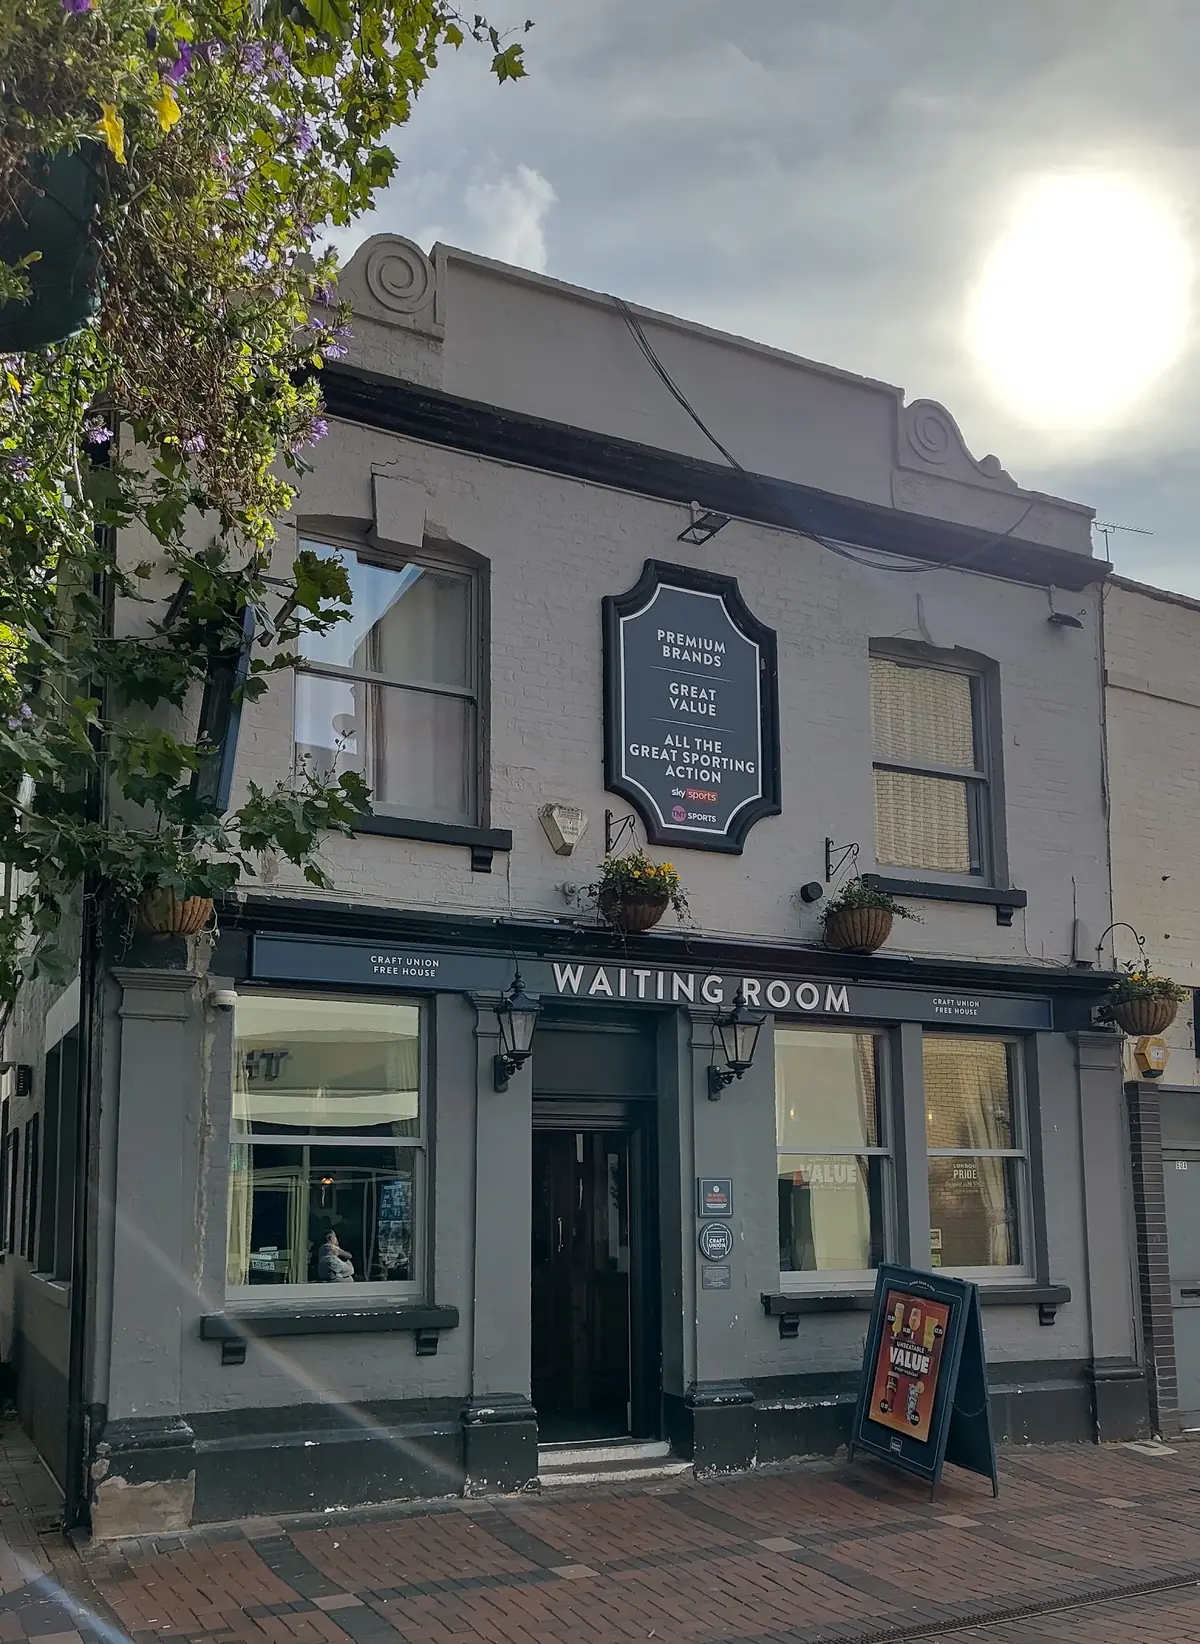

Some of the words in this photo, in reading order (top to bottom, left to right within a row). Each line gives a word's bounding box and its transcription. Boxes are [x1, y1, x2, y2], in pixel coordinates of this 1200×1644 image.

[657, 629, 726, 654] PREMIUM
[662, 645, 722, 667] BRANDS
[669, 682, 717, 701] GREAT
[669, 697, 717, 716] VALUE
[664, 734, 691, 749] ALL
[694, 738, 722, 753] THE
[629, 744, 678, 762] GREAT
[682, 751, 755, 773] SPORTING
[665, 764, 722, 783] ACTION
[671, 787, 686, 799] sky
[687, 791, 717, 802] sports
[687, 812, 717, 823] SPORTS
[370, 955, 403, 965] CRAFT
[406, 958, 440, 967] UNION
[373, 966, 399, 975] FREE
[402, 967, 436, 977] HOUSE
[552, 962, 724, 1004] WAITING
[742, 977, 850, 1013] ROOM
[932, 998, 955, 1006] CRAFT
[956, 1000, 980, 1008] UNION
[935, 1006, 953, 1014] FREE
[954, 1008, 978, 1016] HOUSE
[800, 1163, 857, 1184] VALUE
[953, 1169, 978, 1179] PRIDE
[896, 1340, 925, 1354] UNBEATABLE
[889, 1346, 930, 1374] VALUE
